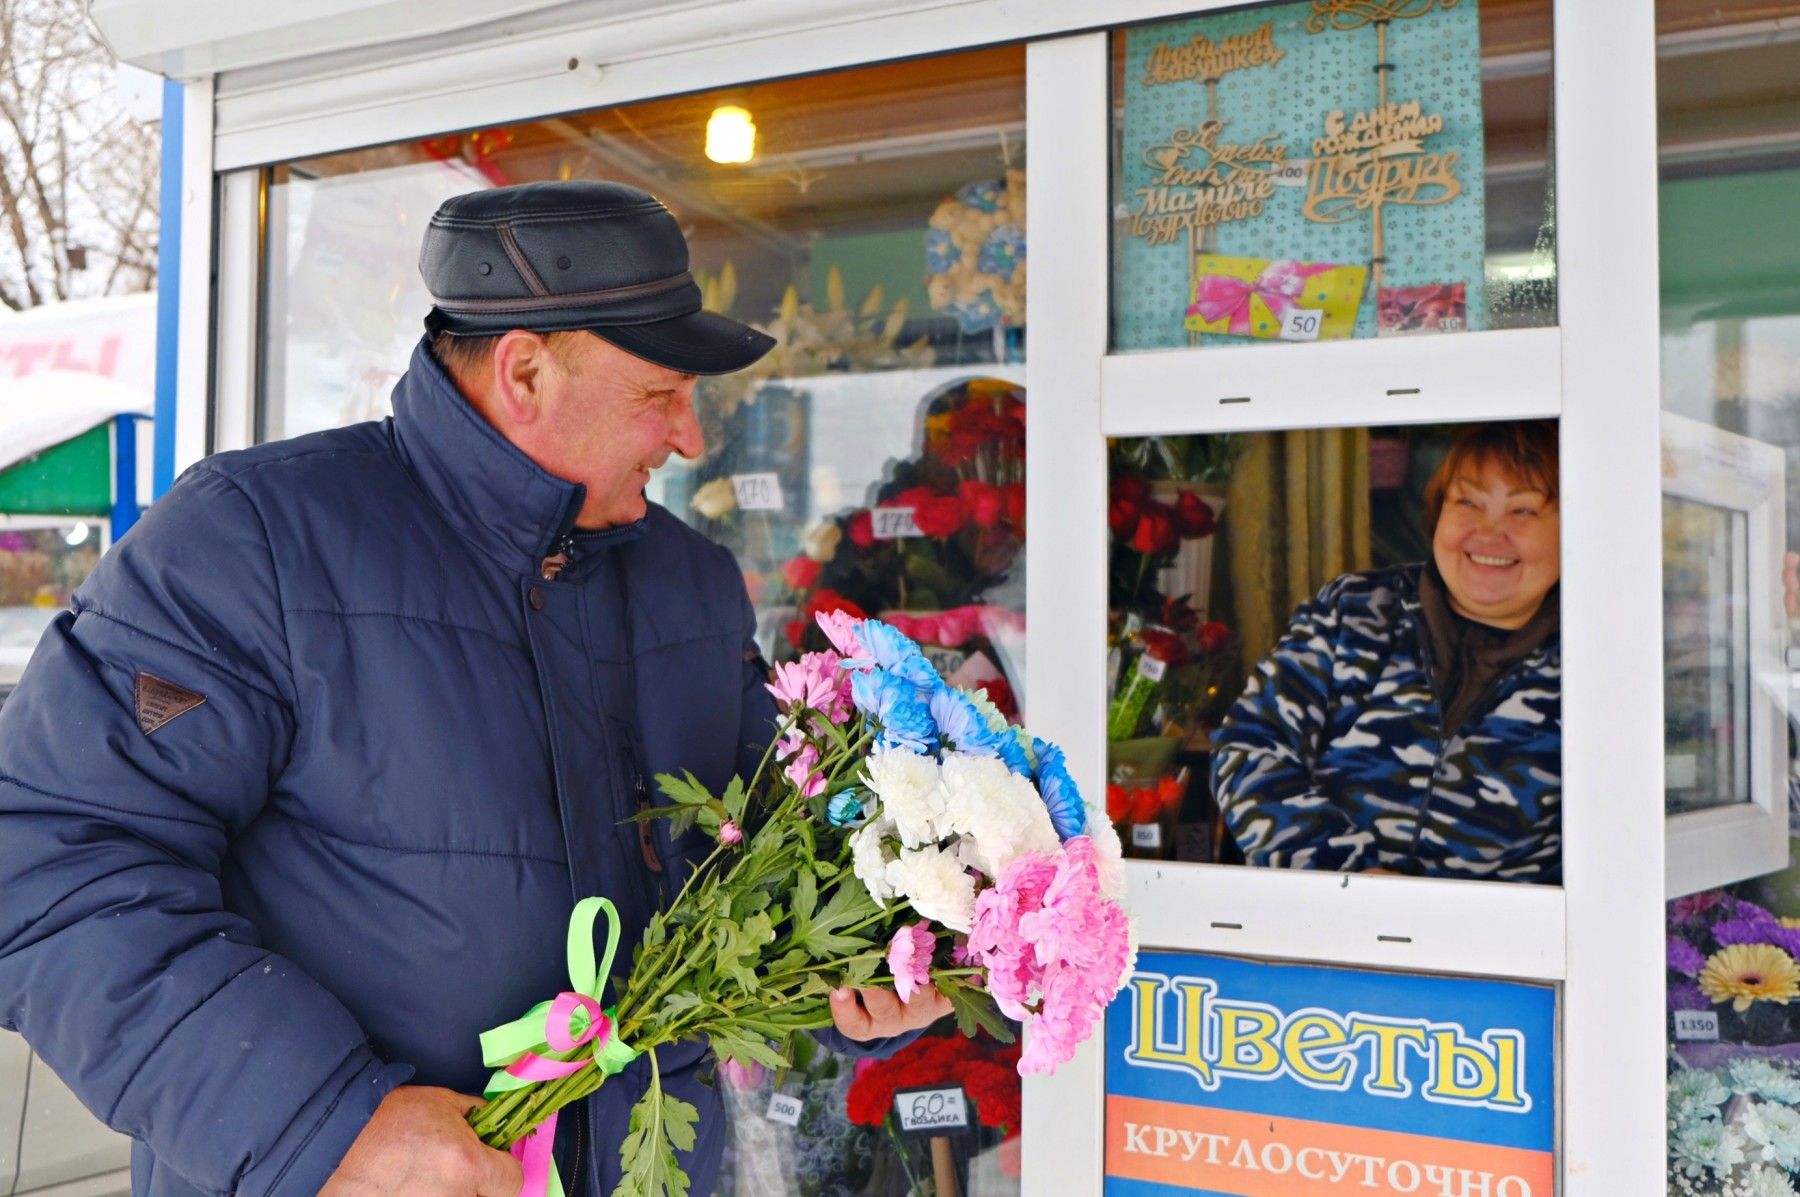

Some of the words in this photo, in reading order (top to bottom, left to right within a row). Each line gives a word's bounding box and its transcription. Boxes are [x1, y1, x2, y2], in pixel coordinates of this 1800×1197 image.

[1291, 316, 1317, 333] 50
[738, 478, 771, 505] 170
[876, 511, 915, 534] 170
[1680, 1018, 1715, 1031] 1350
[1125, 972, 1531, 1113] Цветы
[775, 1102, 796, 1117] 500
[904, 1114, 960, 1127] ГВОЗДИКА
[1123, 1122, 1532, 1197] КРУГЛОСУТОЧНО
